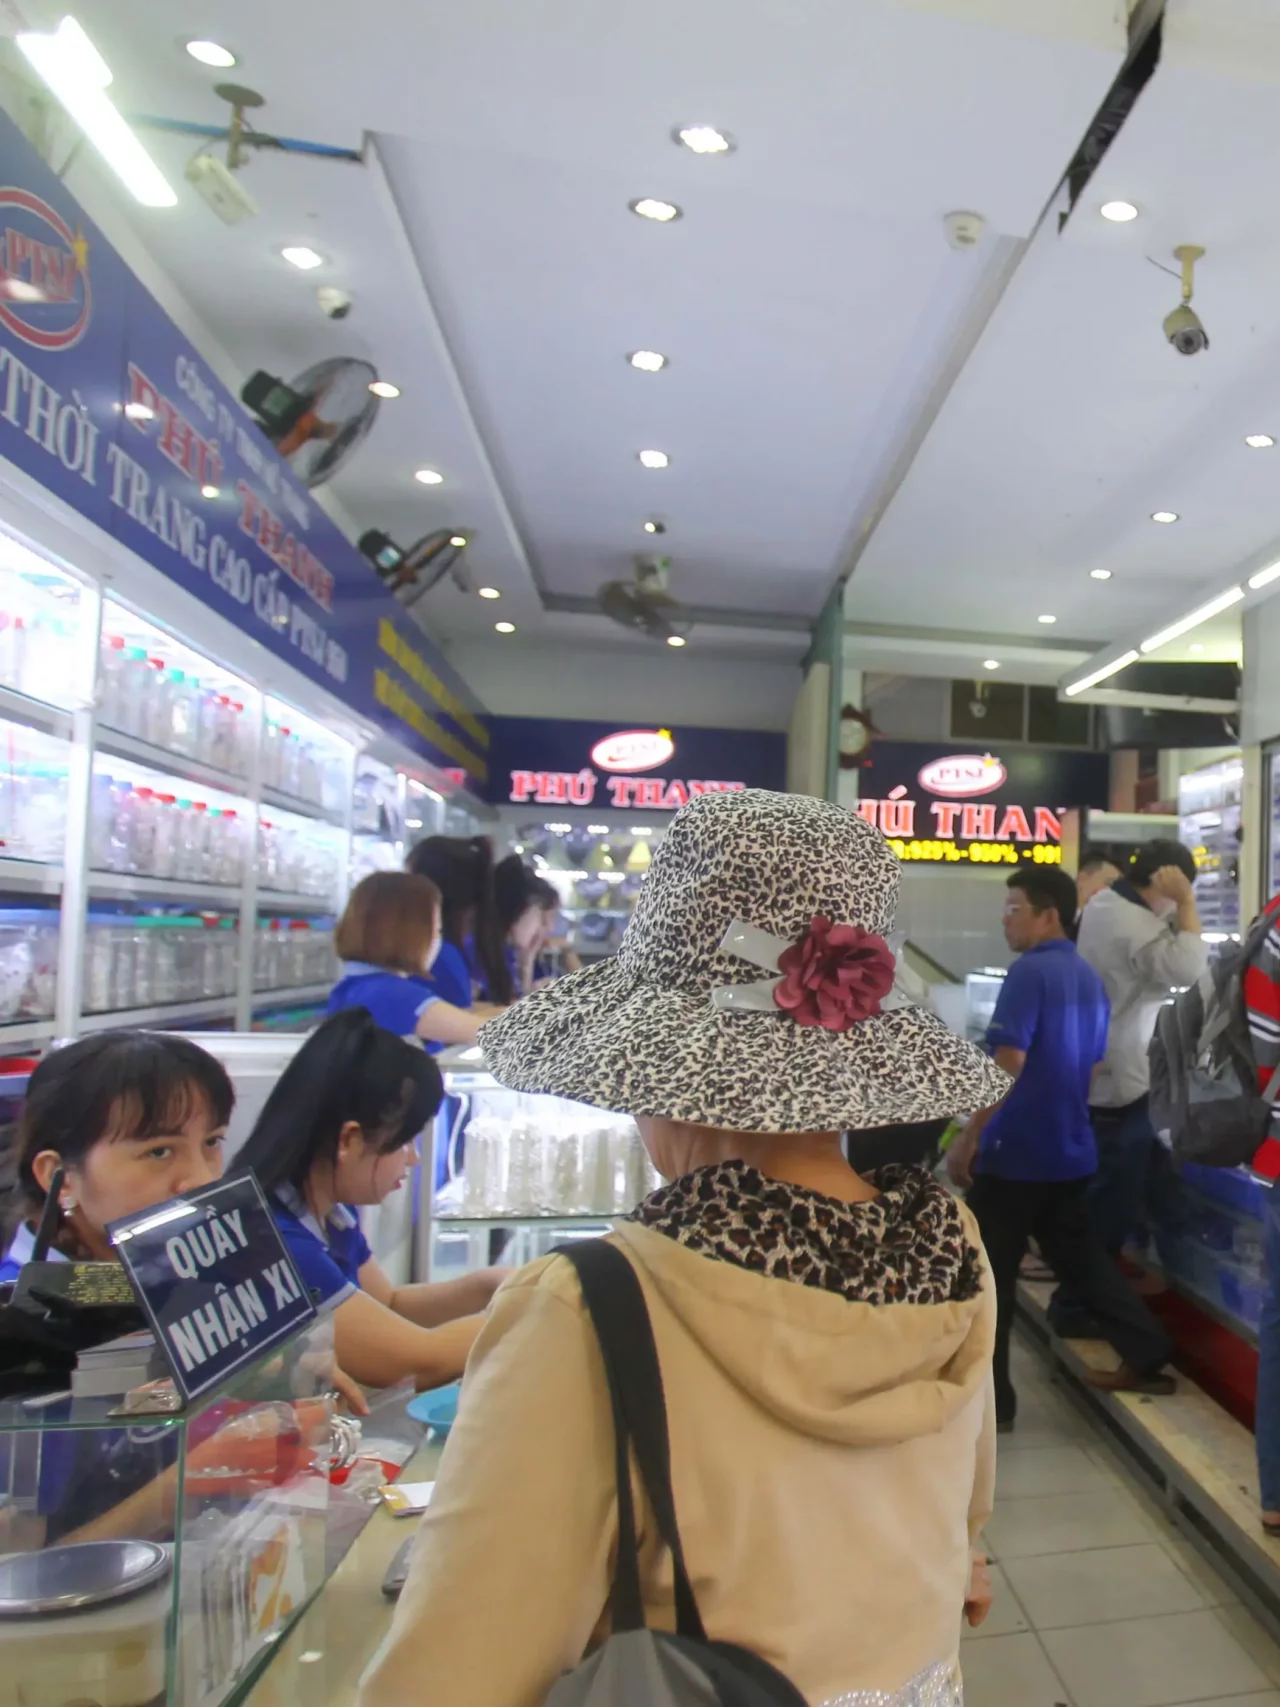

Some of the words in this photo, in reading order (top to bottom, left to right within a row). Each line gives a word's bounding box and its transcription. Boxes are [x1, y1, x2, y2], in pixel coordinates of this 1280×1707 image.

[0, 346, 100, 487] THỜI
[107, 440, 206, 570] TRANG
[209, 534, 251, 605] CAO
[510, 768, 598, 806] PHÚ
[856, 785, 916, 837] HÚ
[929, 801, 1067, 842] THAN
[168, 1278, 268, 1373] NHẬN
[261, 1259, 302, 1311] XI
